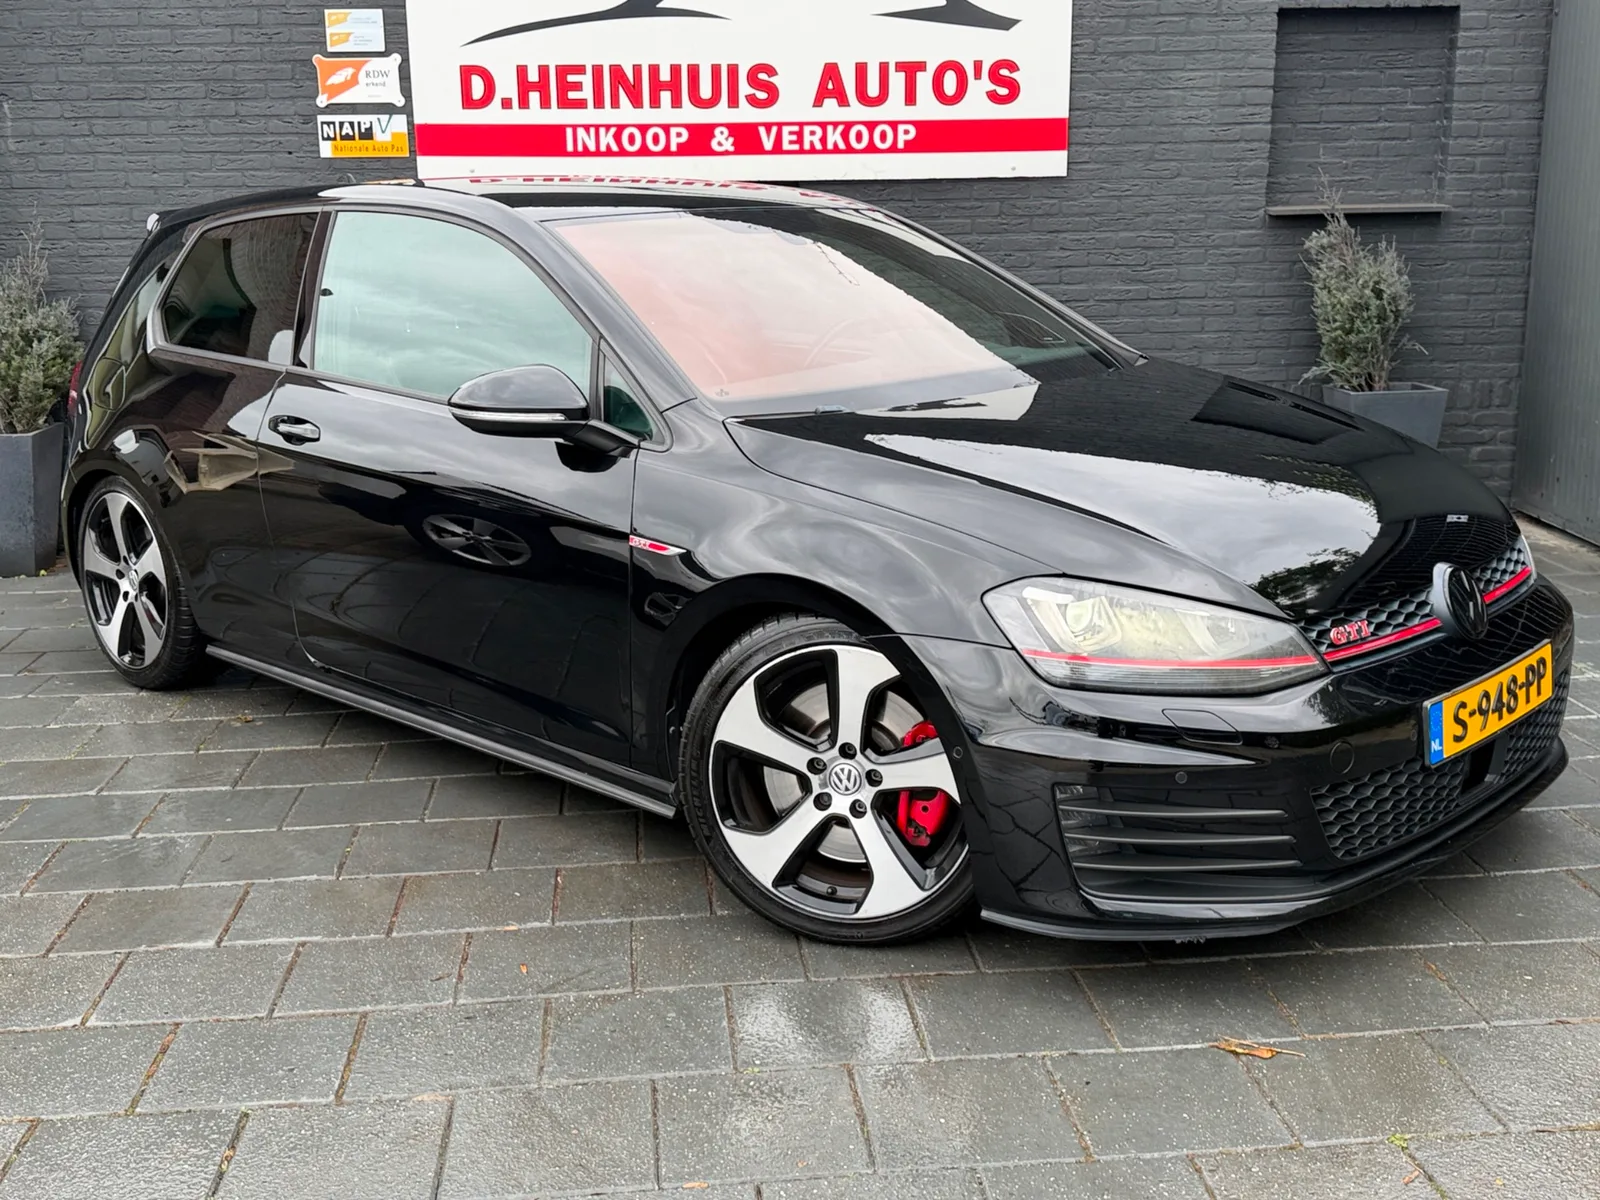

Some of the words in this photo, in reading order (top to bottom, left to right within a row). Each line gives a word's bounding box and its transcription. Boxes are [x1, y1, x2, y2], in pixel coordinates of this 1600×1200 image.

[365, 70, 391, 79] RDW
[459, 63, 780, 110] D.HEINHUIS
[812, 59, 1021, 107] AUTO'S
[334, 144, 369, 152] Nationale
[372, 144, 389, 152] Auto
[391, 144, 405, 152] Pas
[565, 126, 689, 153] INKOOP
[710, 126, 735, 152] &
[758, 124, 917, 151] VERKOOP
[1329, 619, 1371, 646] GTI
[1452, 656, 1547, 744] S-948-PP
[1431, 738, 1443, 752] NL
